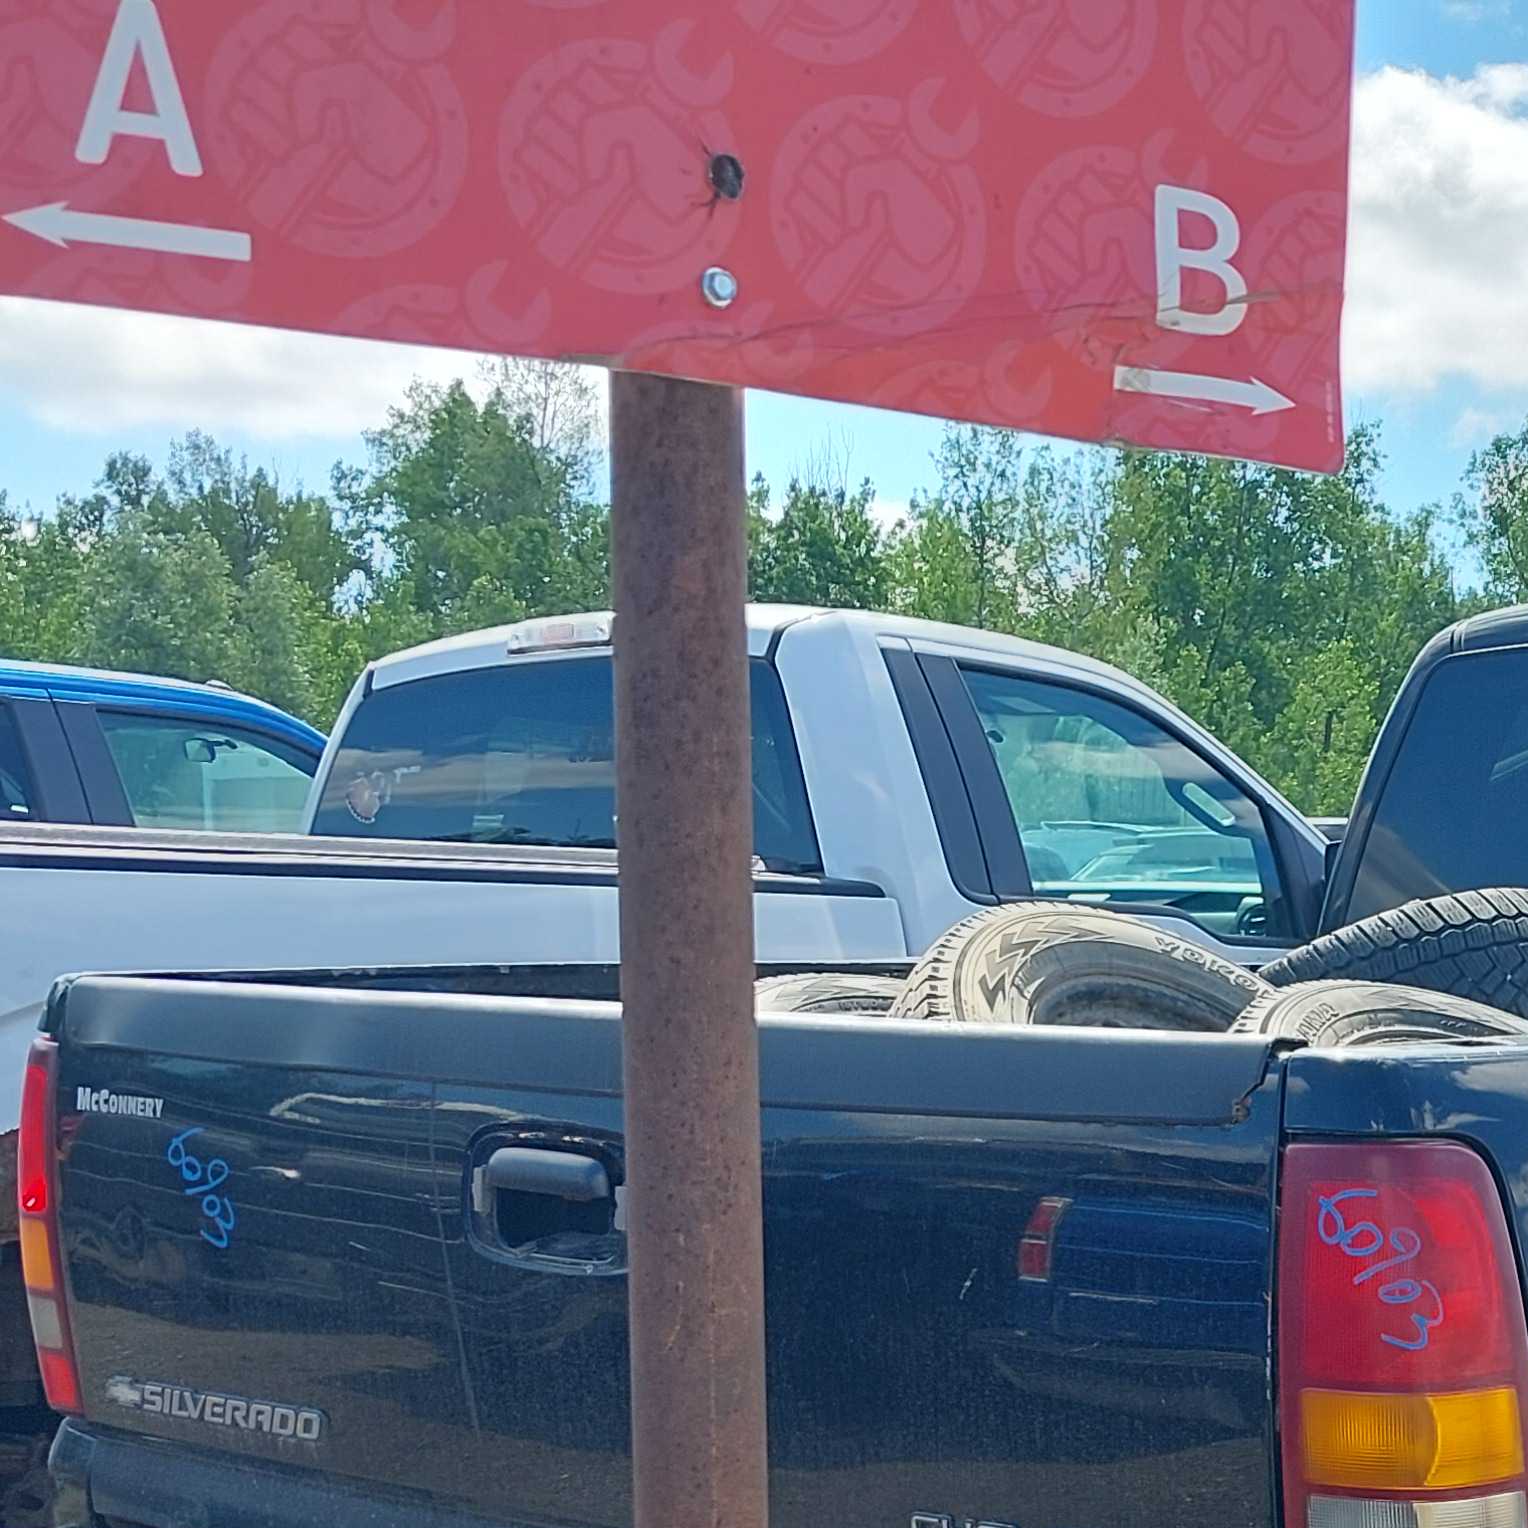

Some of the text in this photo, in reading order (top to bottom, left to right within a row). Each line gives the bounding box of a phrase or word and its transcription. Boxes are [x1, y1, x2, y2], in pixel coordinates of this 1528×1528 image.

[75, 0, 203, 177] A
[1155, 184, 1248, 336] B
[142, 1384, 321, 1440] SILVERADO
